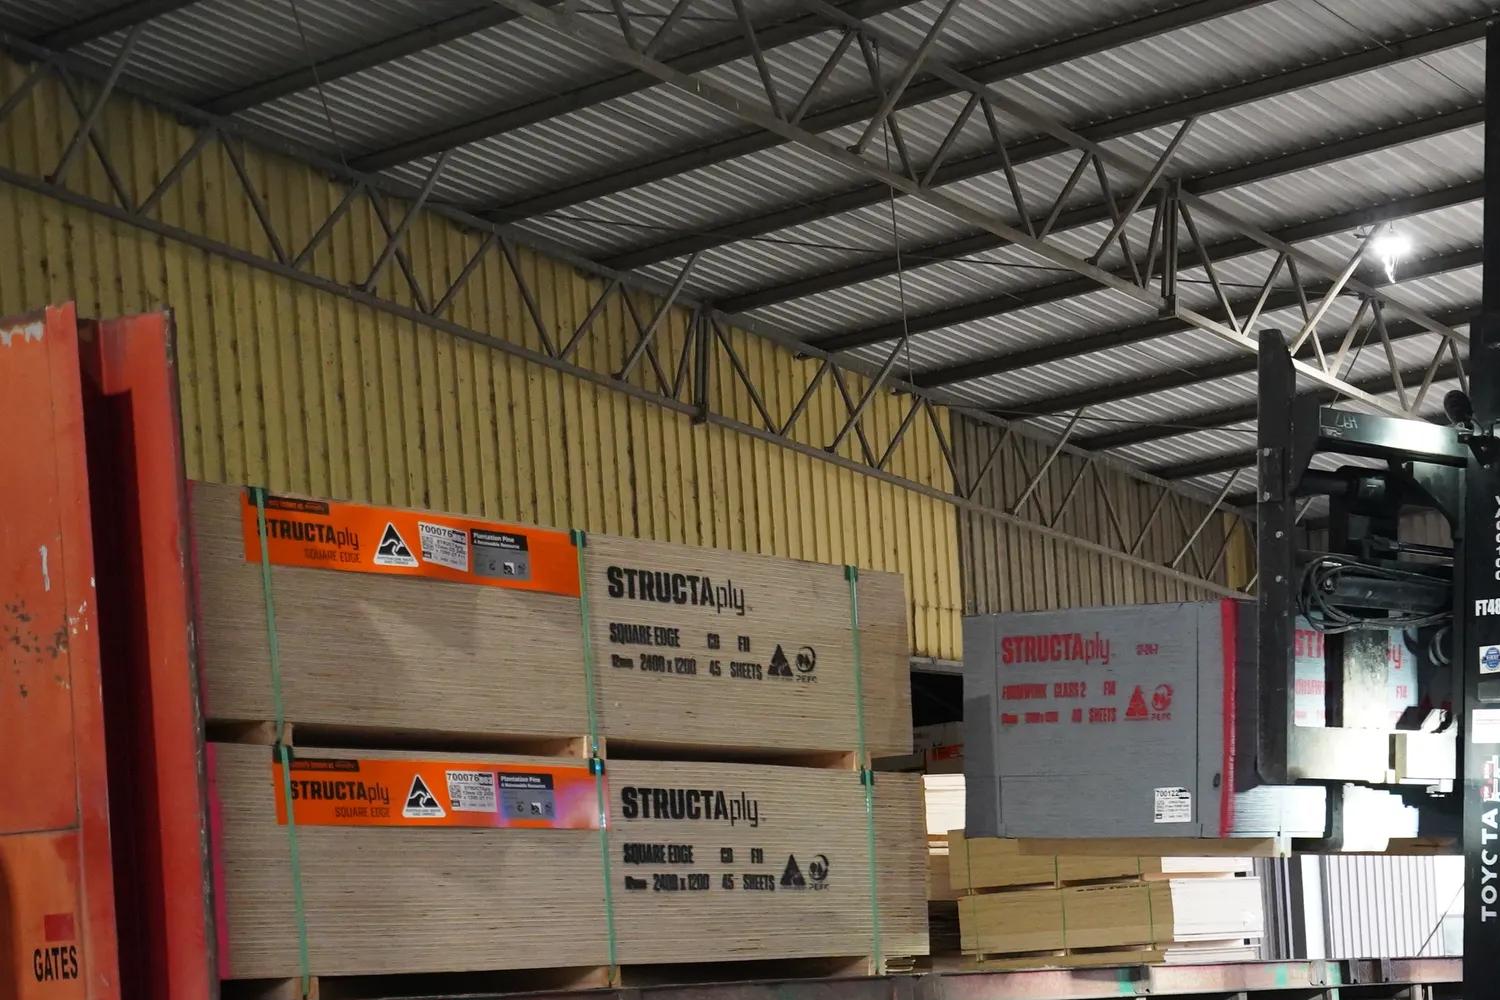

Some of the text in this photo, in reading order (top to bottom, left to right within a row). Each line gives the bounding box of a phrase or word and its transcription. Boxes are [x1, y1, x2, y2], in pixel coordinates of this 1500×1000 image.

[304, 549, 361, 564] SQUARE EDGE
[607, 565, 745, 616] STRUCTAply
[609, 622, 653, 645] SQUARE
[654, 626, 681, 648] EDGE
[1001, 632, 1110, 665] STRUCTAply
[709, 659, 721, 677] 45
[730, 661, 763, 681] SHEETS
[335, 806, 369, 818] SQUARE
[371, 806, 391, 818] EDGE
[621, 786, 759, 828] STRUCTAply
[623, 843, 667, 866] SQUARE
[667, 844, 695, 864] EDGE
[722, 873, 734, 890] 45
[742, 874, 775, 892] SHEETS
[33, 945, 78, 983] GATES
